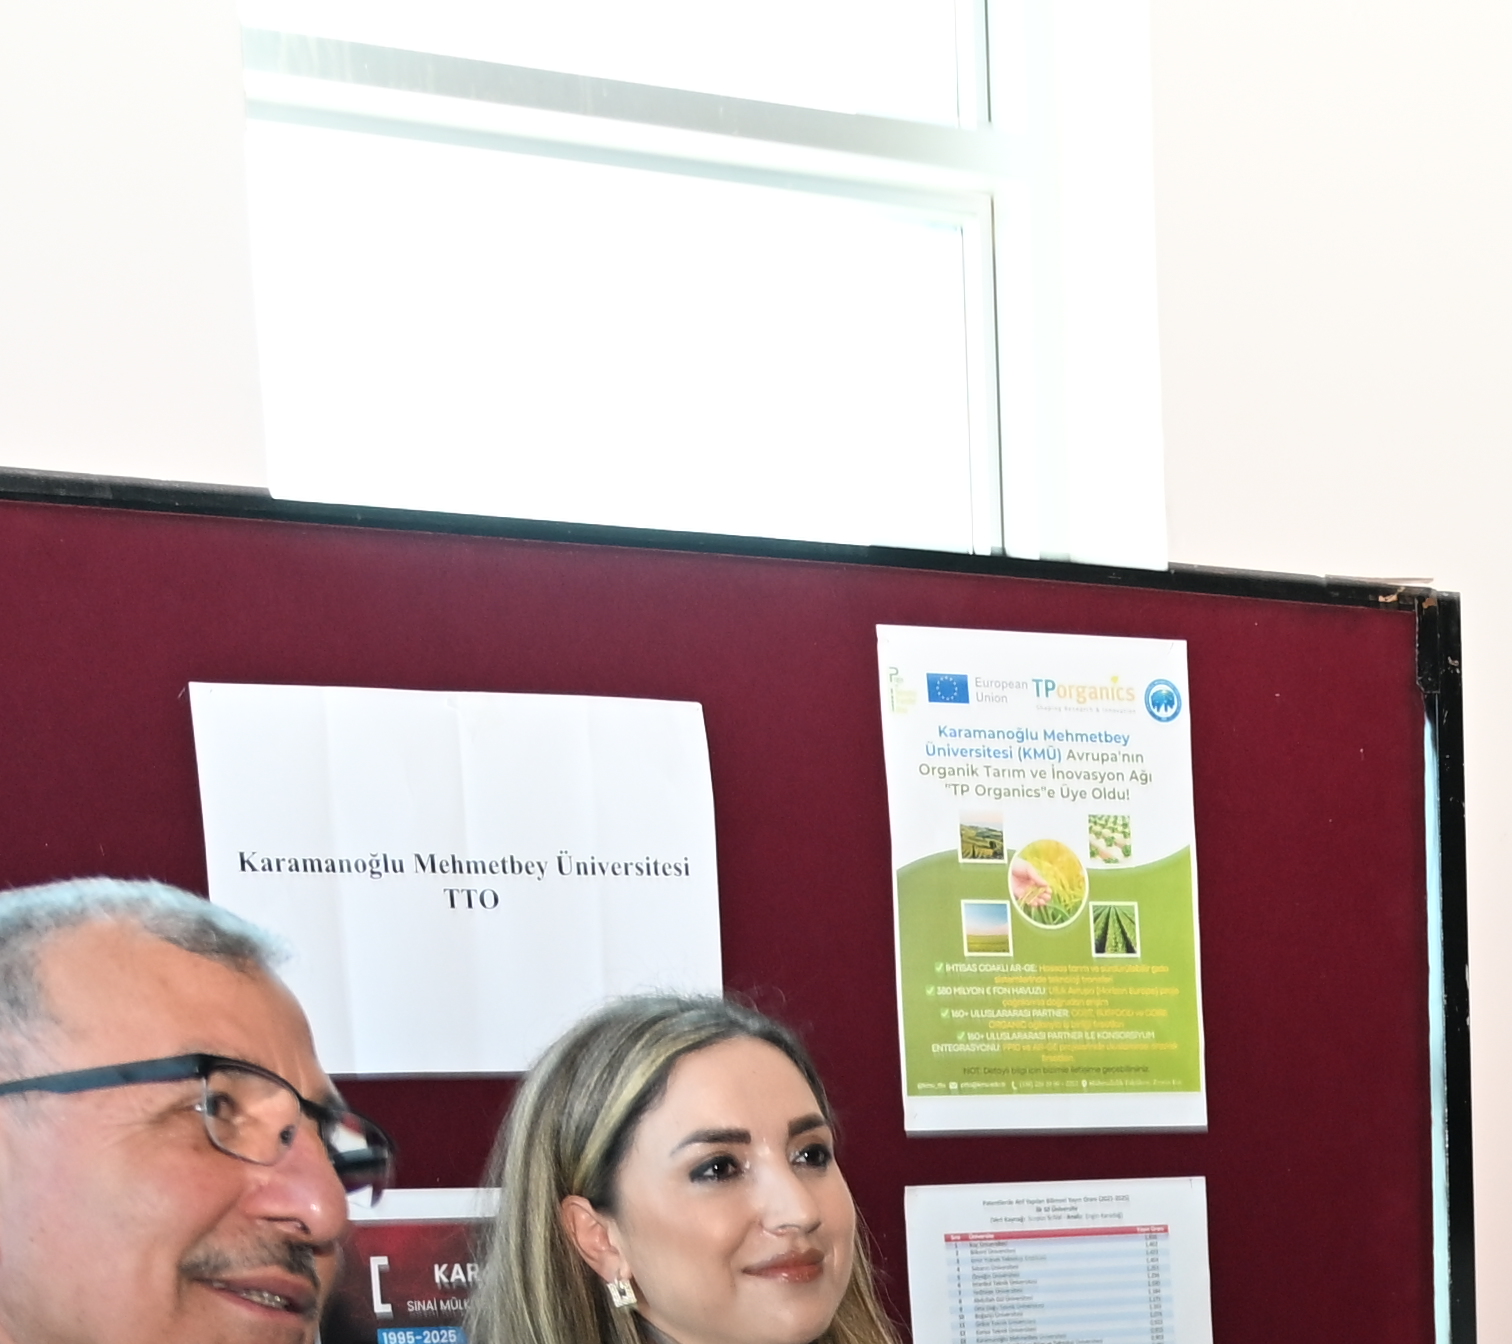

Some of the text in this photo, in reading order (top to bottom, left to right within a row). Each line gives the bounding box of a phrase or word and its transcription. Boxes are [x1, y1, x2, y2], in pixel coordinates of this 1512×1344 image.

[975, 677, 1029, 691] European
[976, 692, 1008, 704] Union
[938, 725, 1130, 747] Karamanoğlu Mehmetbey
[925, 743, 1144, 765] Üniversitesi (KMÜ) Avrupa'nın
[918, 763, 1153, 786] Organik Tarım ve İnovasyon Ağı
[1060, 783, 1088, 802] Üye
[1091, 787, 1130, 801] Oldu!
[237, 849, 691, 881] Karamanoğlu Mehmetbey Üniversitesi
[443, 887, 500, 910] TTO
